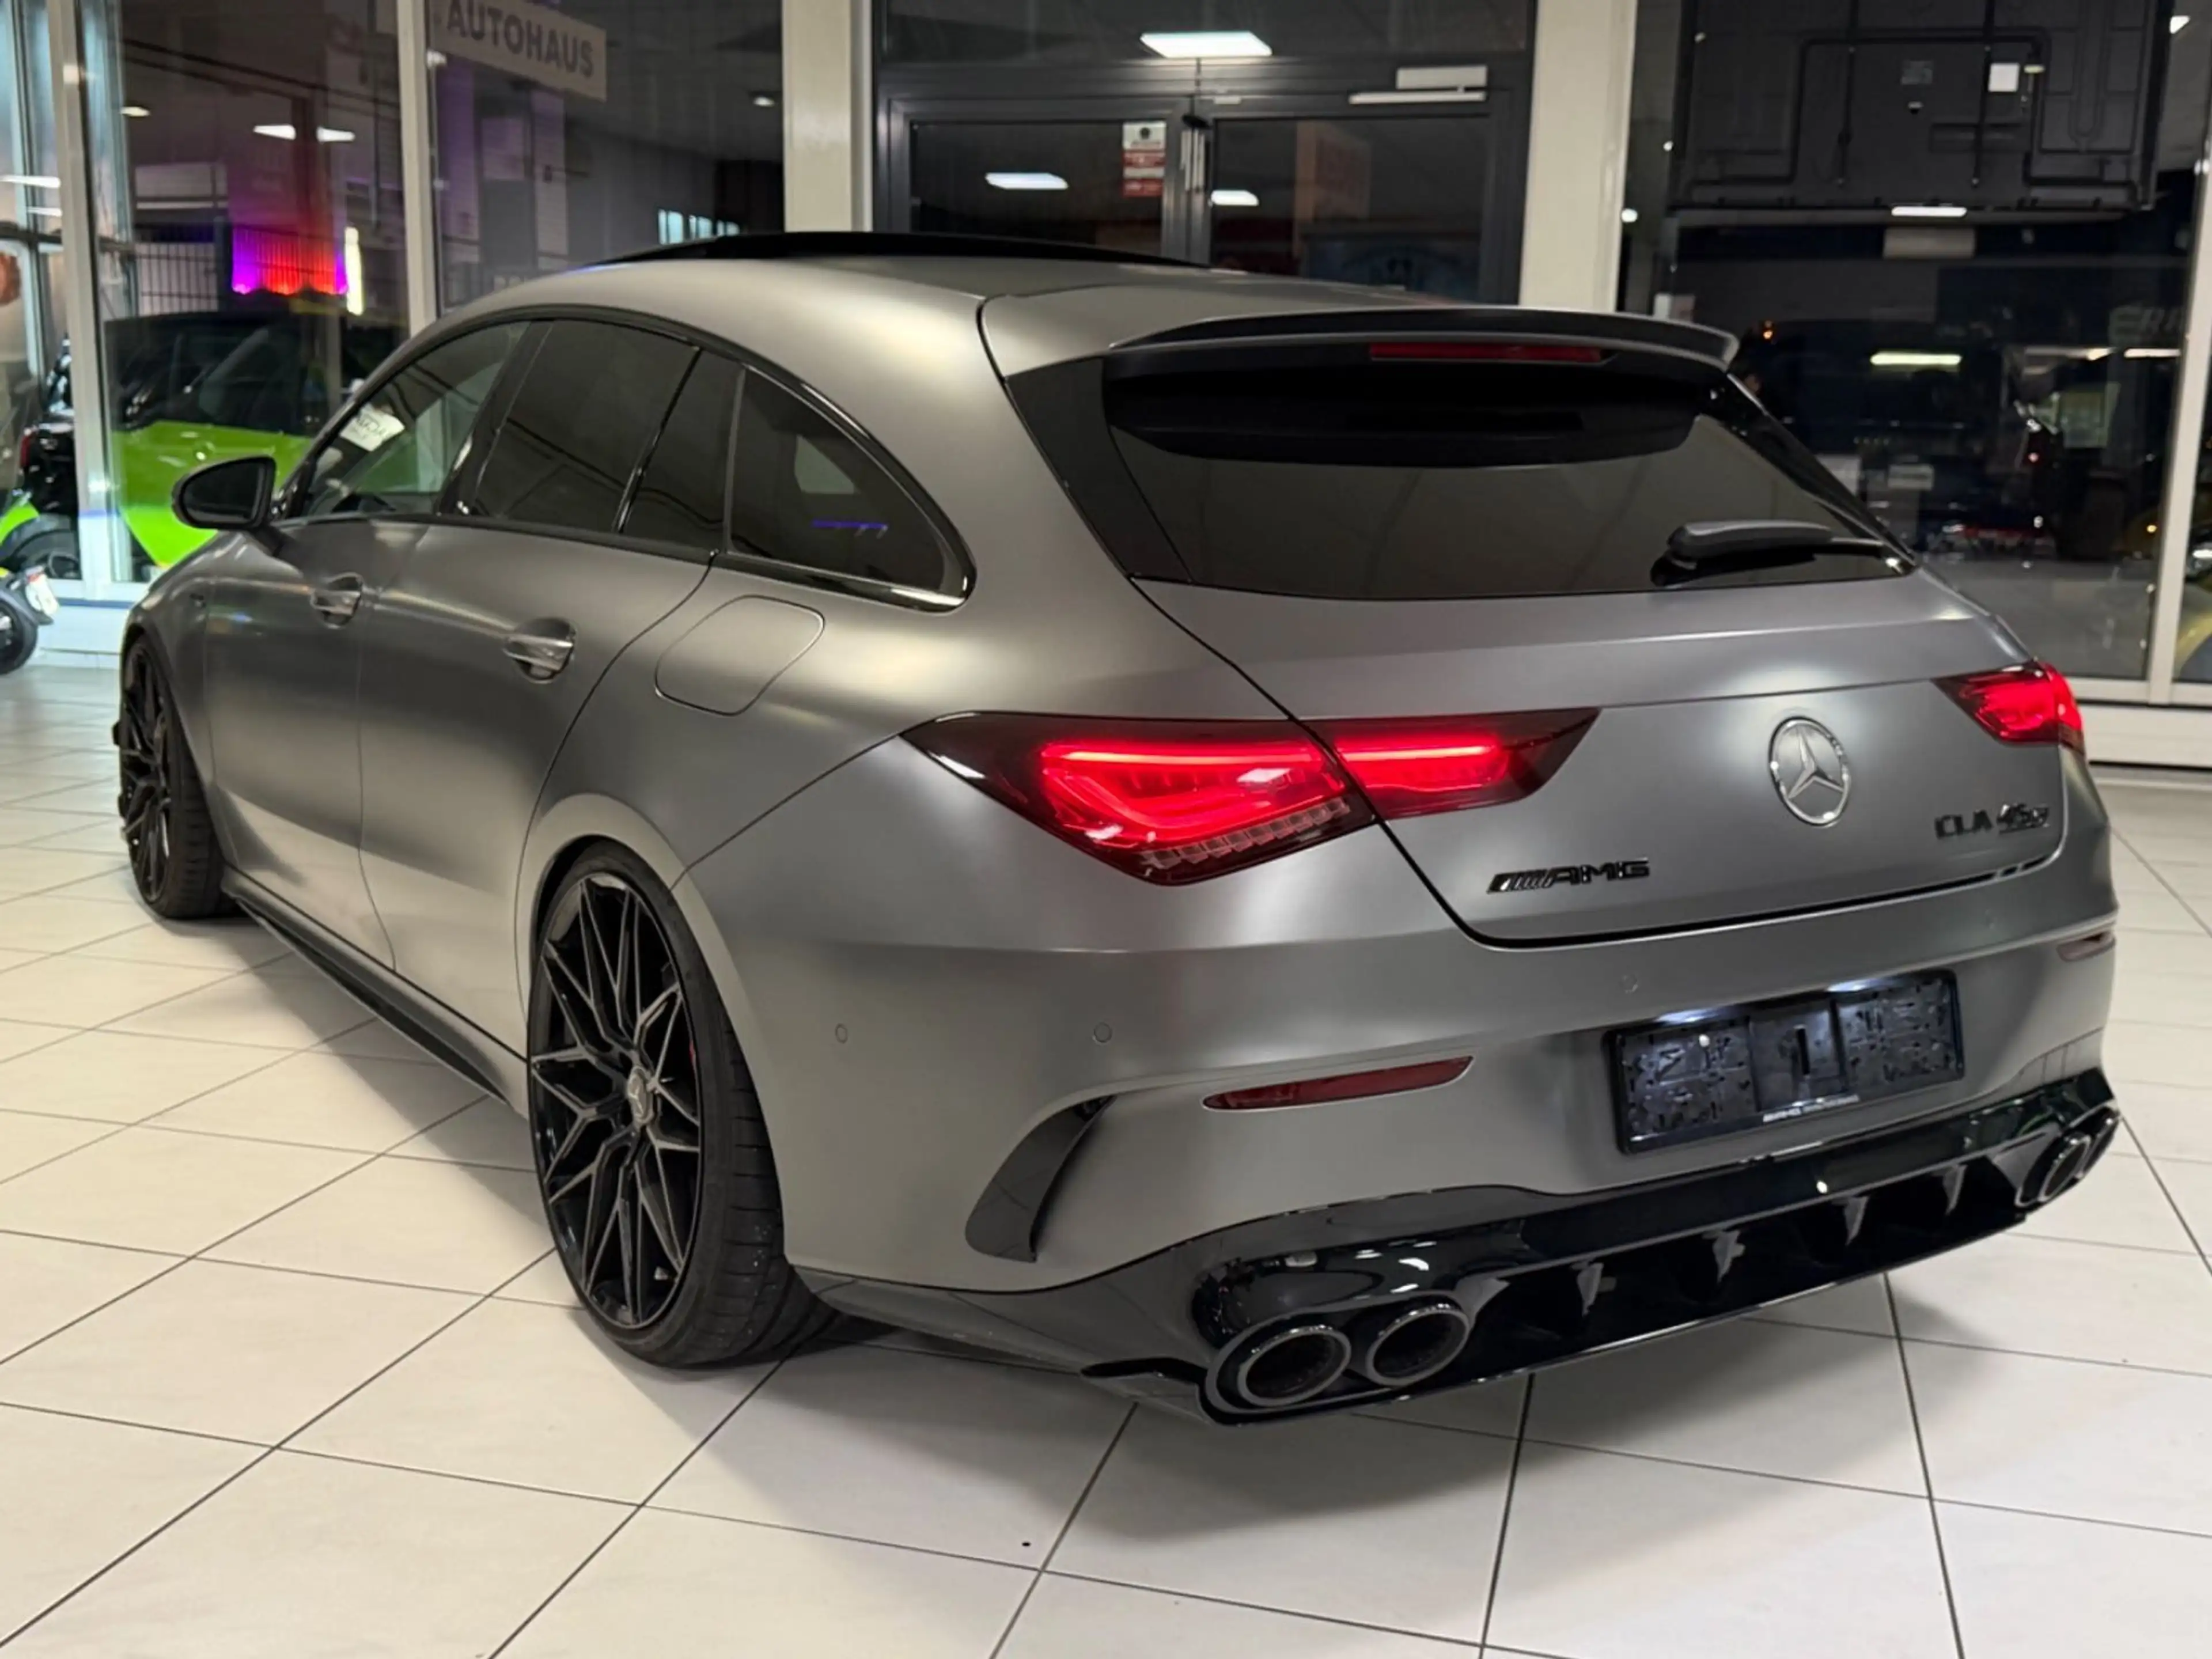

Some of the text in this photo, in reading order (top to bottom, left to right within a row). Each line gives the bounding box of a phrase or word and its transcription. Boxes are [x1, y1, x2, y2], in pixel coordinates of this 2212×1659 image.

[446, 0, 593, 78] AUTOHAUS
[1934, 809, 1993, 839] CLA
[1539, 857, 1650, 888] AMG
